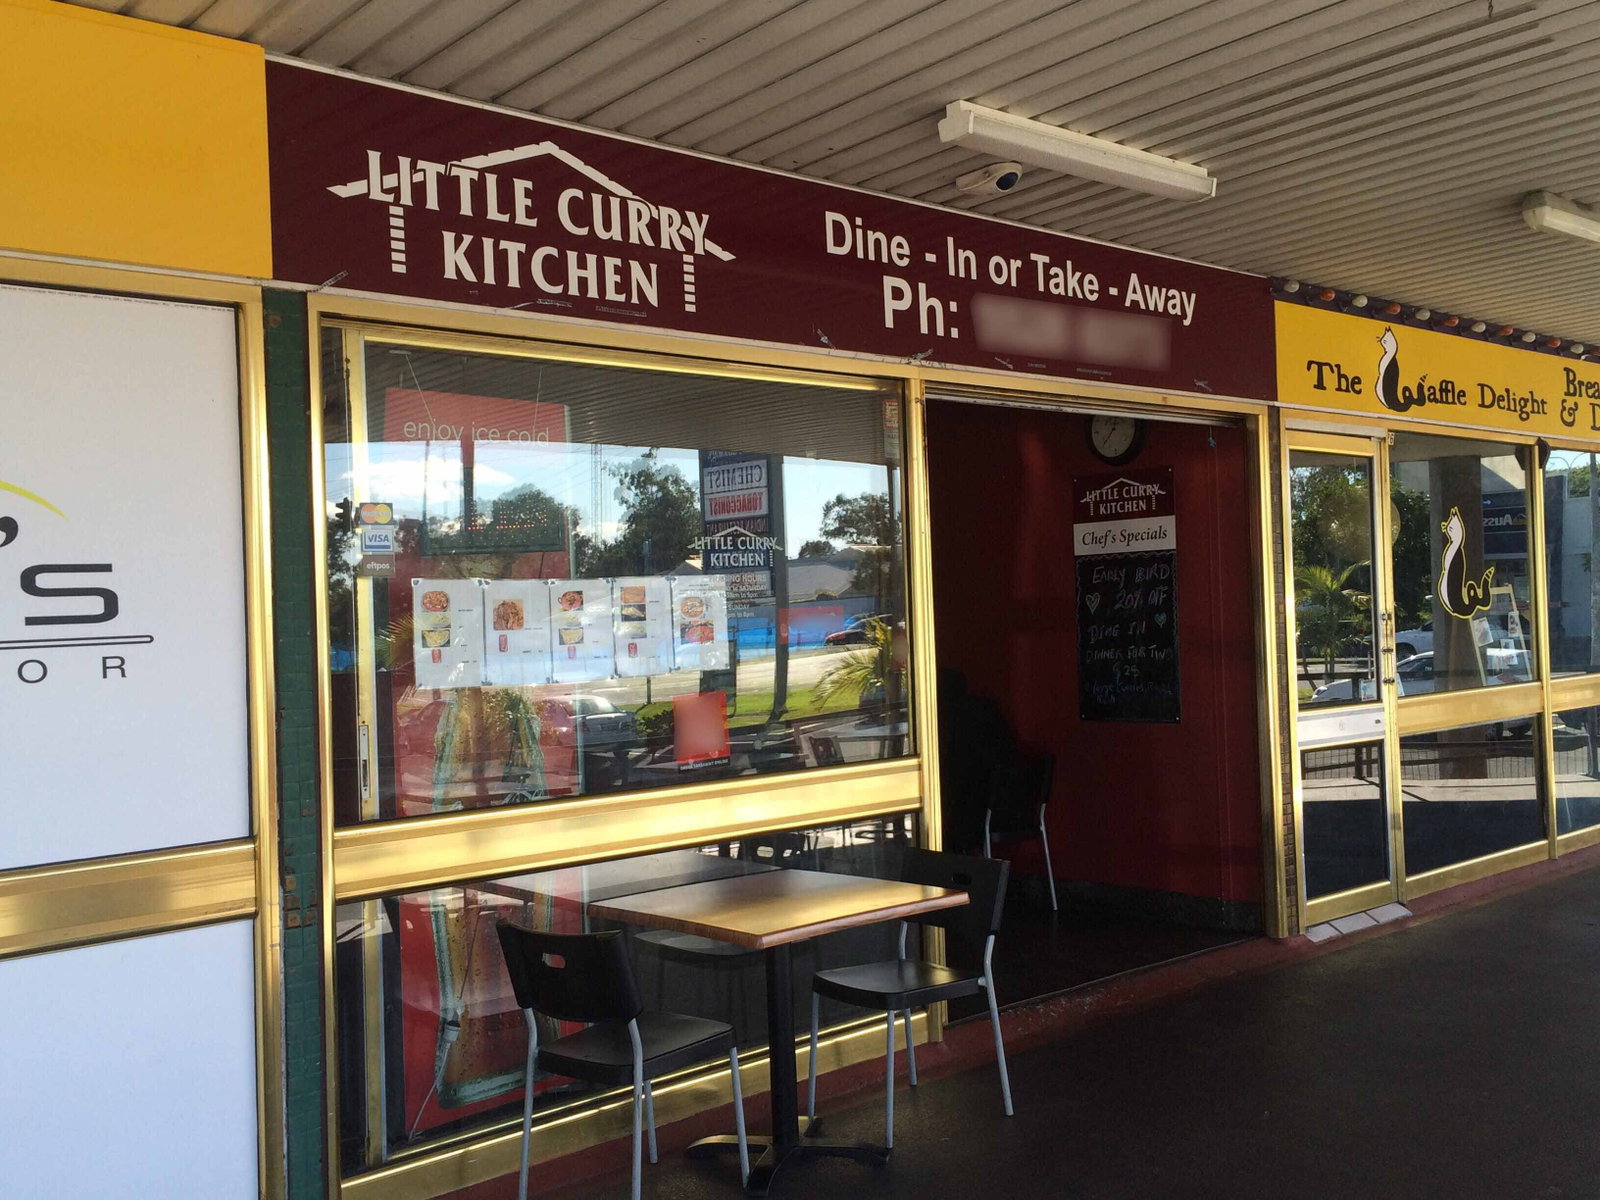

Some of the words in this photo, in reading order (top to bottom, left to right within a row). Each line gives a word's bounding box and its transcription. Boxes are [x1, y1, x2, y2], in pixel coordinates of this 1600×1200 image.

[366, 149, 537, 227] LITTLE
[557, 187, 709, 256] CURRY
[441, 230, 658, 308] KITCHEN
[824, 211, 911, 267] Dine
[946, 236, 977, 280] In
[988, 253, 1022, 287] or
[1030, 253, 1100, 301] Take
[1124, 272, 1196, 326] Away
[882, 275, 959, 339] Ph:
[1306, 360, 1363, 395] The
[1477, 383, 1548, 422] Delight
[472, 421, 500, 441] ice
[507, 426, 549, 447] cold
[1086, 488, 1120, 502] LITTLE
[1122, 483, 1160, 498] CURRY
[1099, 499, 1147, 515] KITCHEN
[368, 534, 390, 543] VISA
[694, 536, 734, 550] LITTLE
[737, 536, 778, 551] CURRY
[1082, 529, 1117, 549] Chef's
[1119, 525, 1168, 547] Specials
[366, 561, 390, 571] eftpos
[710, 552, 764, 567] KITCHEN
[741, 572, 767, 583] HOURS
